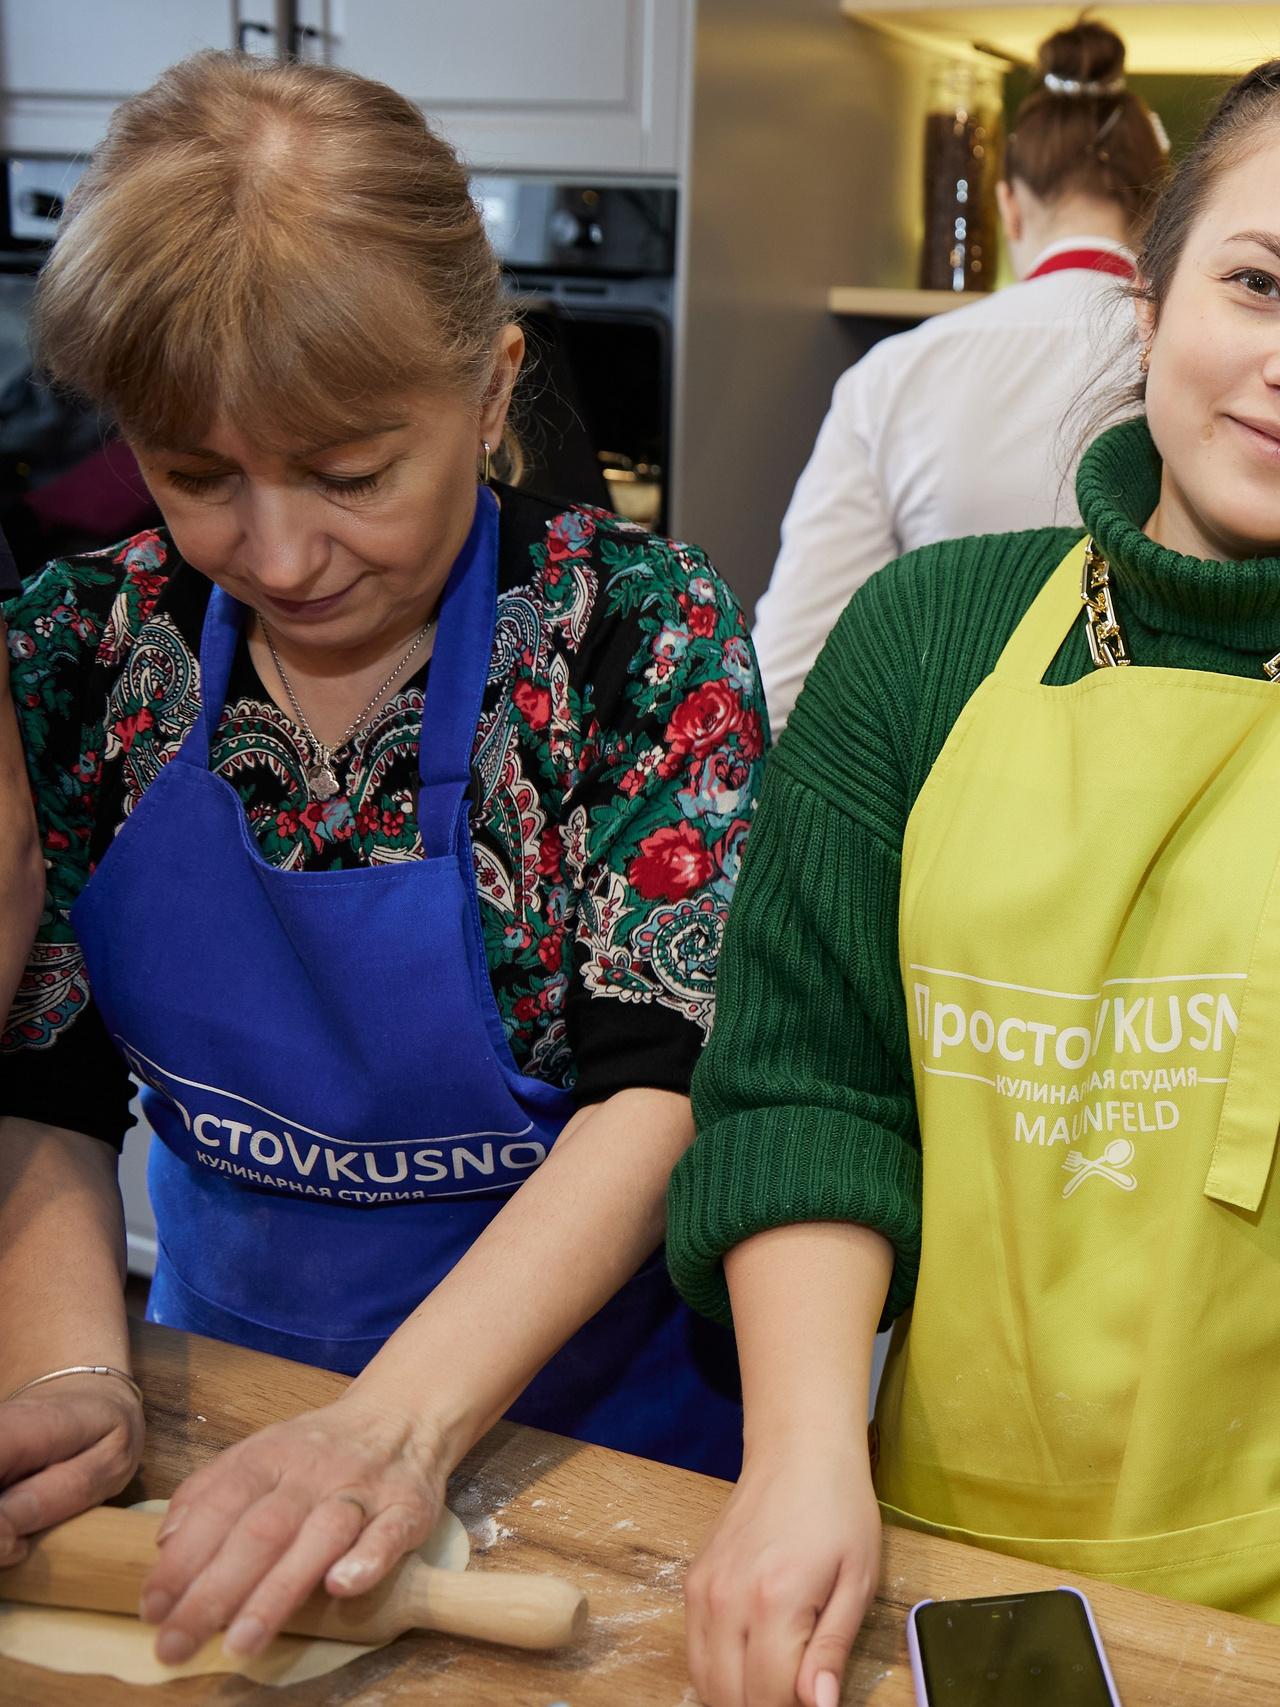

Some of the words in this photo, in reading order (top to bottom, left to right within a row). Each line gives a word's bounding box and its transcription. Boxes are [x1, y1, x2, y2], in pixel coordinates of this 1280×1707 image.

[1120, 1066, 1198, 1094] СТУДИЯ
[1014, 1101, 1180, 1146] MAUNFELD
[196, 1150, 333, 1199] КУЛИНАРНАЯ
[338, 1189, 426, 1204] СТУДИЯ
